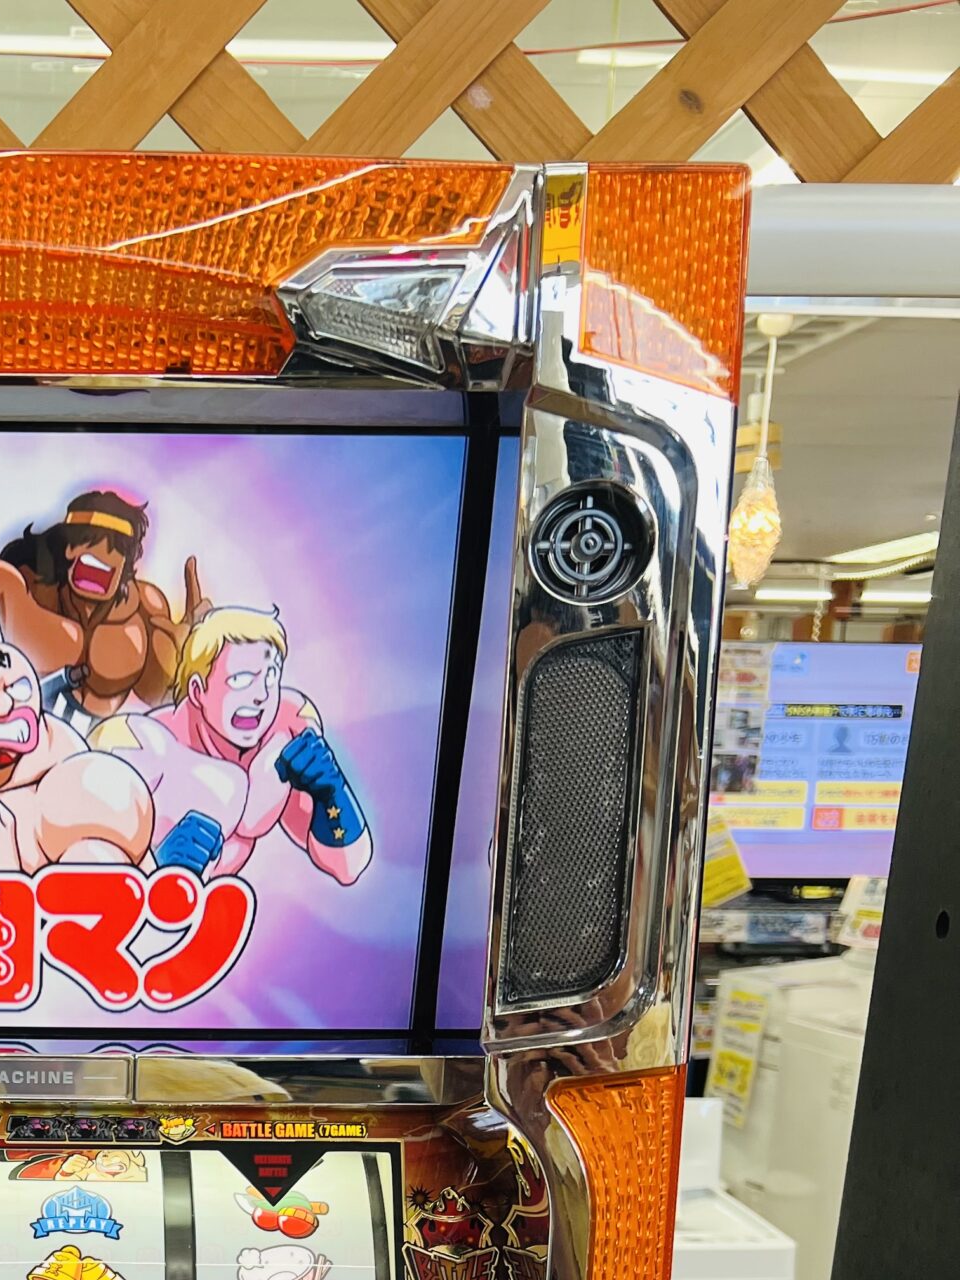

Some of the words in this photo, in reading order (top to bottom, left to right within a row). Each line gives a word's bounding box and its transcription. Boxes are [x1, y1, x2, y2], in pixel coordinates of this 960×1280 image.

[221, 1122, 272, 1138] BATTLE
[274, 1122, 315, 1138] GAME
[318, 1124, 369, 1138] (7GAME)
[46, 1217, 109, 1231] REPLAY
